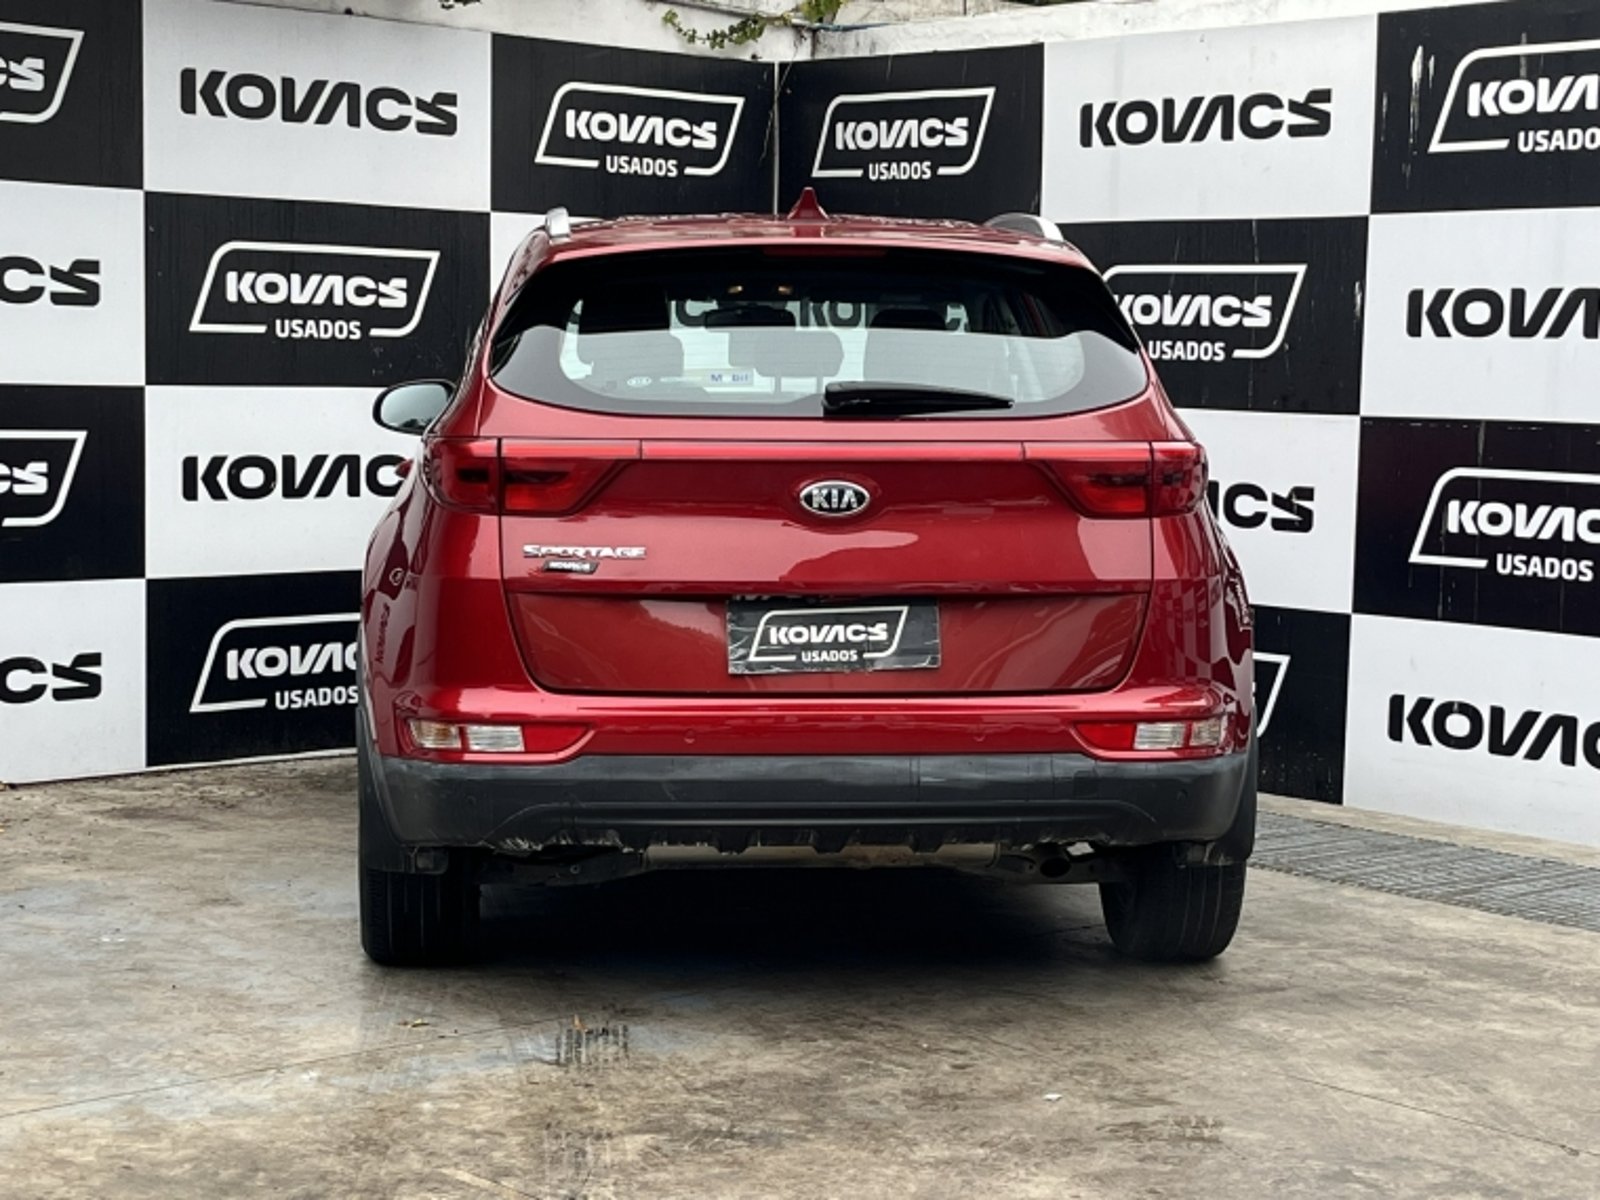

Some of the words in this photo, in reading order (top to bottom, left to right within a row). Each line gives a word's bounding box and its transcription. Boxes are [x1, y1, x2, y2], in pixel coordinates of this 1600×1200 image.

[181, 67, 458, 137] KOVACS
[1467, 74, 1600, 117] KOVA
[565, 109, 717, 150] KOVACS
[1080, 88, 1332, 148] KOVACS
[834, 117, 969, 149] KOVACS
[605, 154, 678, 178] USADOS
[868, 161, 932, 181] USADOS
[226, 271, 408, 308] KOVACS
[1406, 287, 1600, 340] KOVA
[275, 318, 362, 340] USADOS
[1148, 340, 1226, 362] USADOS
[811, 487, 859, 509] KIA
[522, 544, 646, 560] SPORTAGE
[1496, 553, 1594, 582] USADOS
[769, 622, 889, 645] KOVACS
[801, 649, 858, 662] USADOS
[274, 685, 358, 710] USADOS
